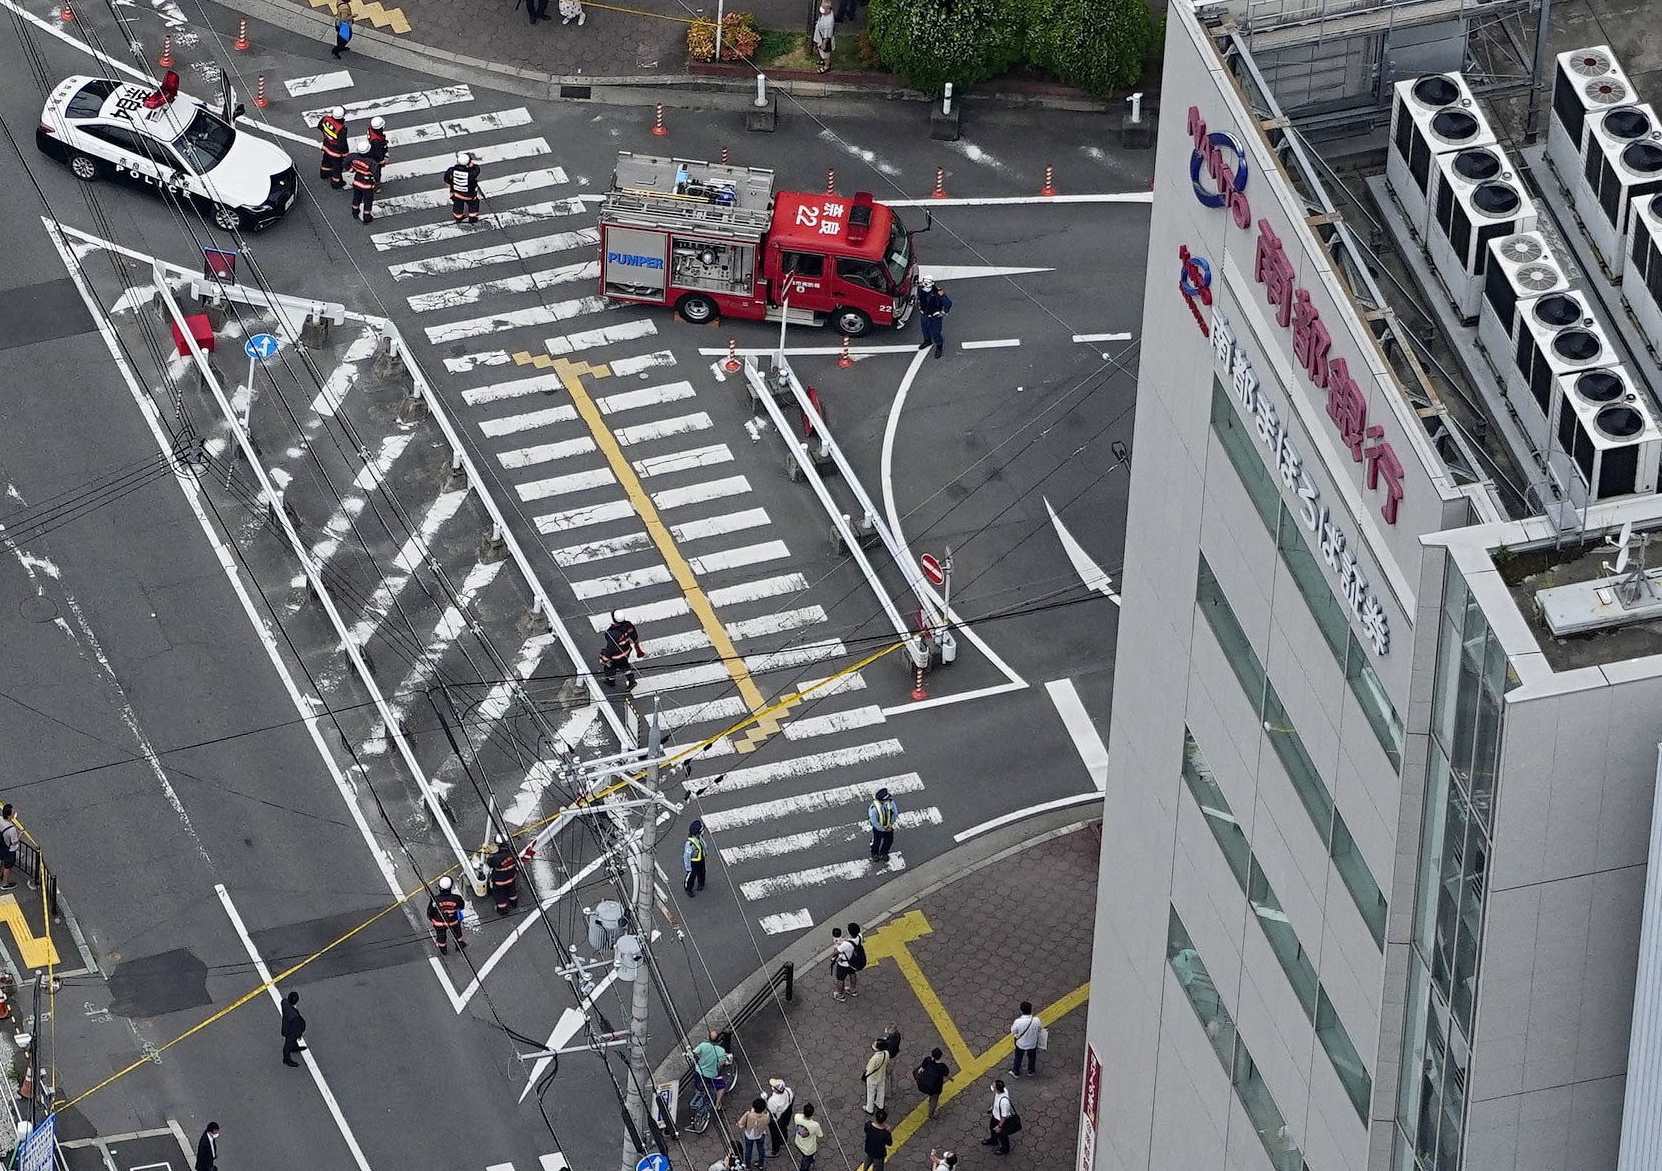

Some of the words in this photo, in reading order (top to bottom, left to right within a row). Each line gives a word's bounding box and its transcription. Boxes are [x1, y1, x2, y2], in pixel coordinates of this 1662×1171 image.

[115, 164, 192, 199] POLICE
[795, 204, 818, 227] 22
[818, 201, 845, 235] 奈良
[608, 251, 664, 270] PUMPER
[879, 304, 892, 313] 22
[1254, 218, 1404, 526] 南都銀行
